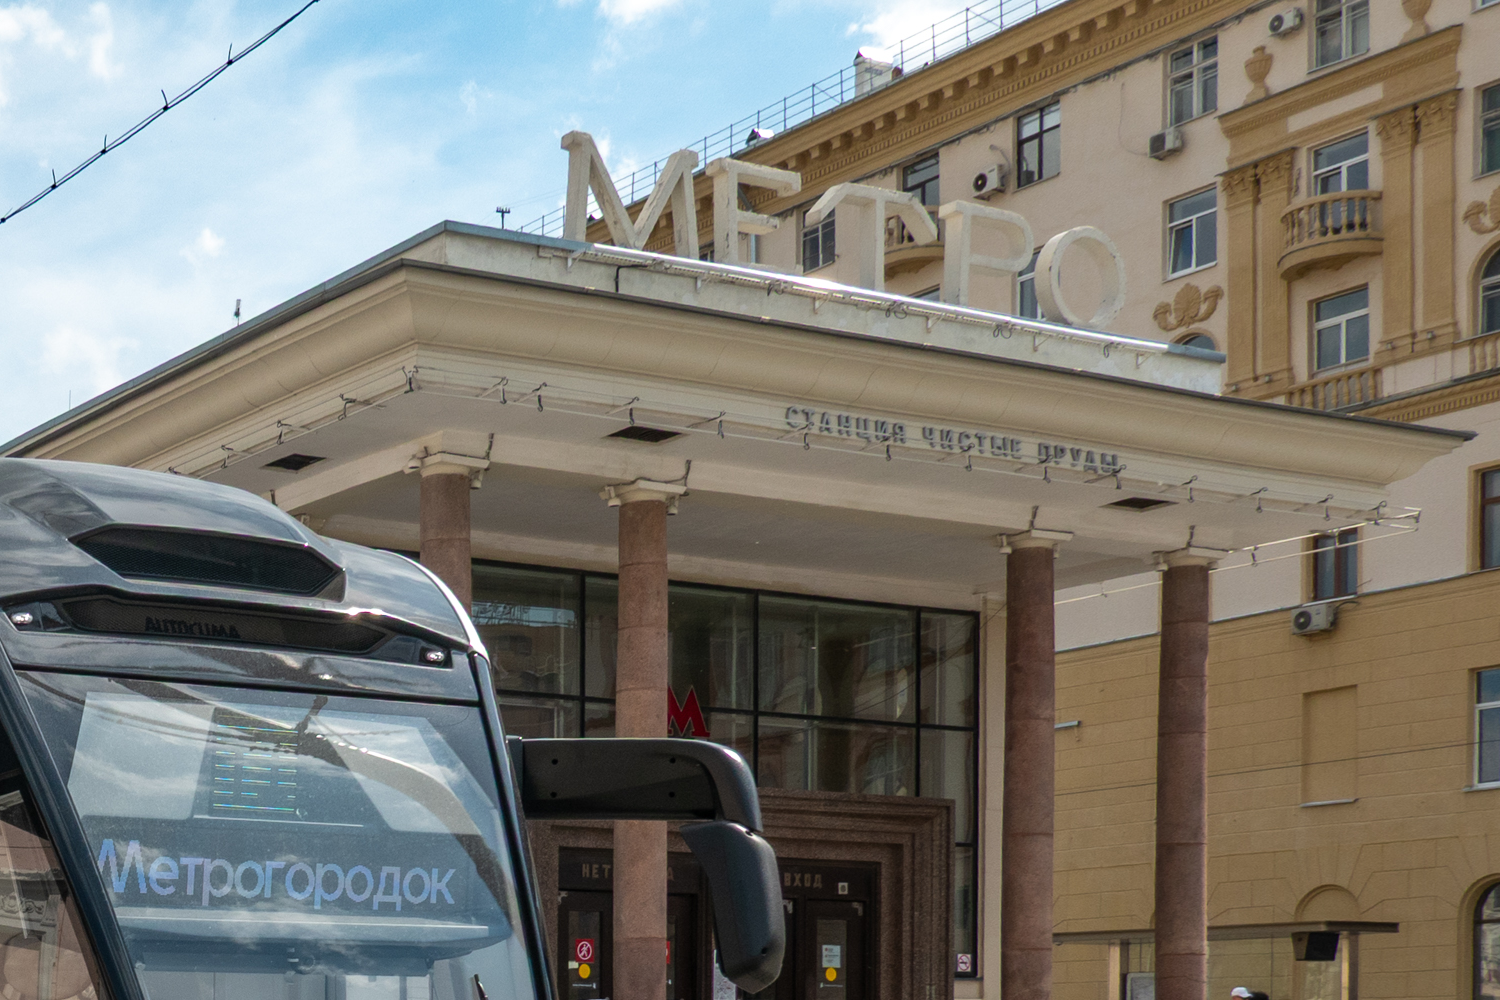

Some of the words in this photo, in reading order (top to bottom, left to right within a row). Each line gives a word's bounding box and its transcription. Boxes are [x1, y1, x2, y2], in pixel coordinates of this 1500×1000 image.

[561, 130, 1127, 329] МЕТРО
[785, 405, 906, 444] СТАНЦИЯ
[922, 426, 1022, 459] ЧИСТЫЕ
[1037, 442, 1122, 474] ПРУДЫ
[98, 839, 456, 911] Метрогородок
[582, 863, 611, 879] НЕТ
[784, 872, 822, 888] ВХОД
